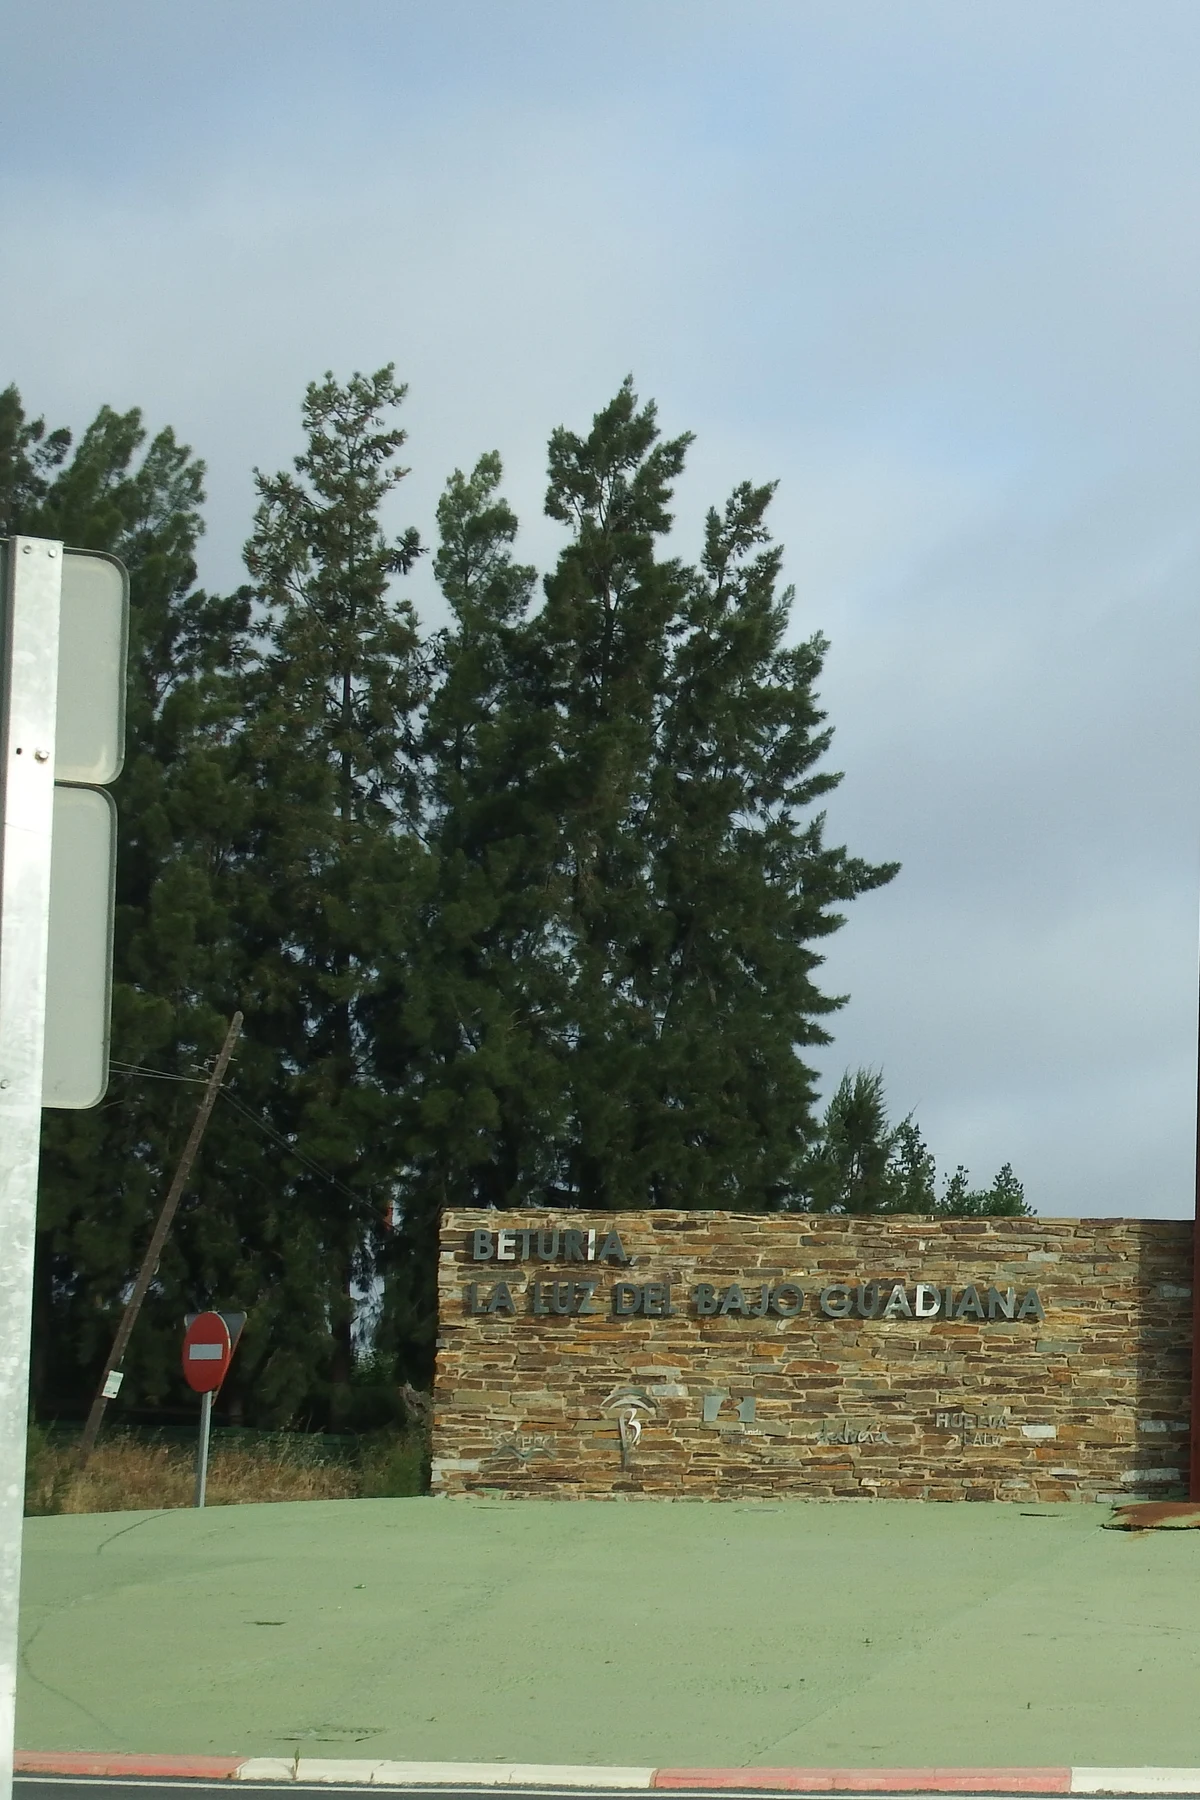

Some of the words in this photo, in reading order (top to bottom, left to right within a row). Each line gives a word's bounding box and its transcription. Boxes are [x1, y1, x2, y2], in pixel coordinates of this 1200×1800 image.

[473, 1228, 637, 1266] BETURIA,
[471, 1281, 517, 1314] LA
[533, 1281, 601, 1314] LUZ
[616, 1283, 680, 1314] DEL
[697, 1283, 804, 1316] BAJO
[819, 1284, 1046, 1320] GUADIANA
